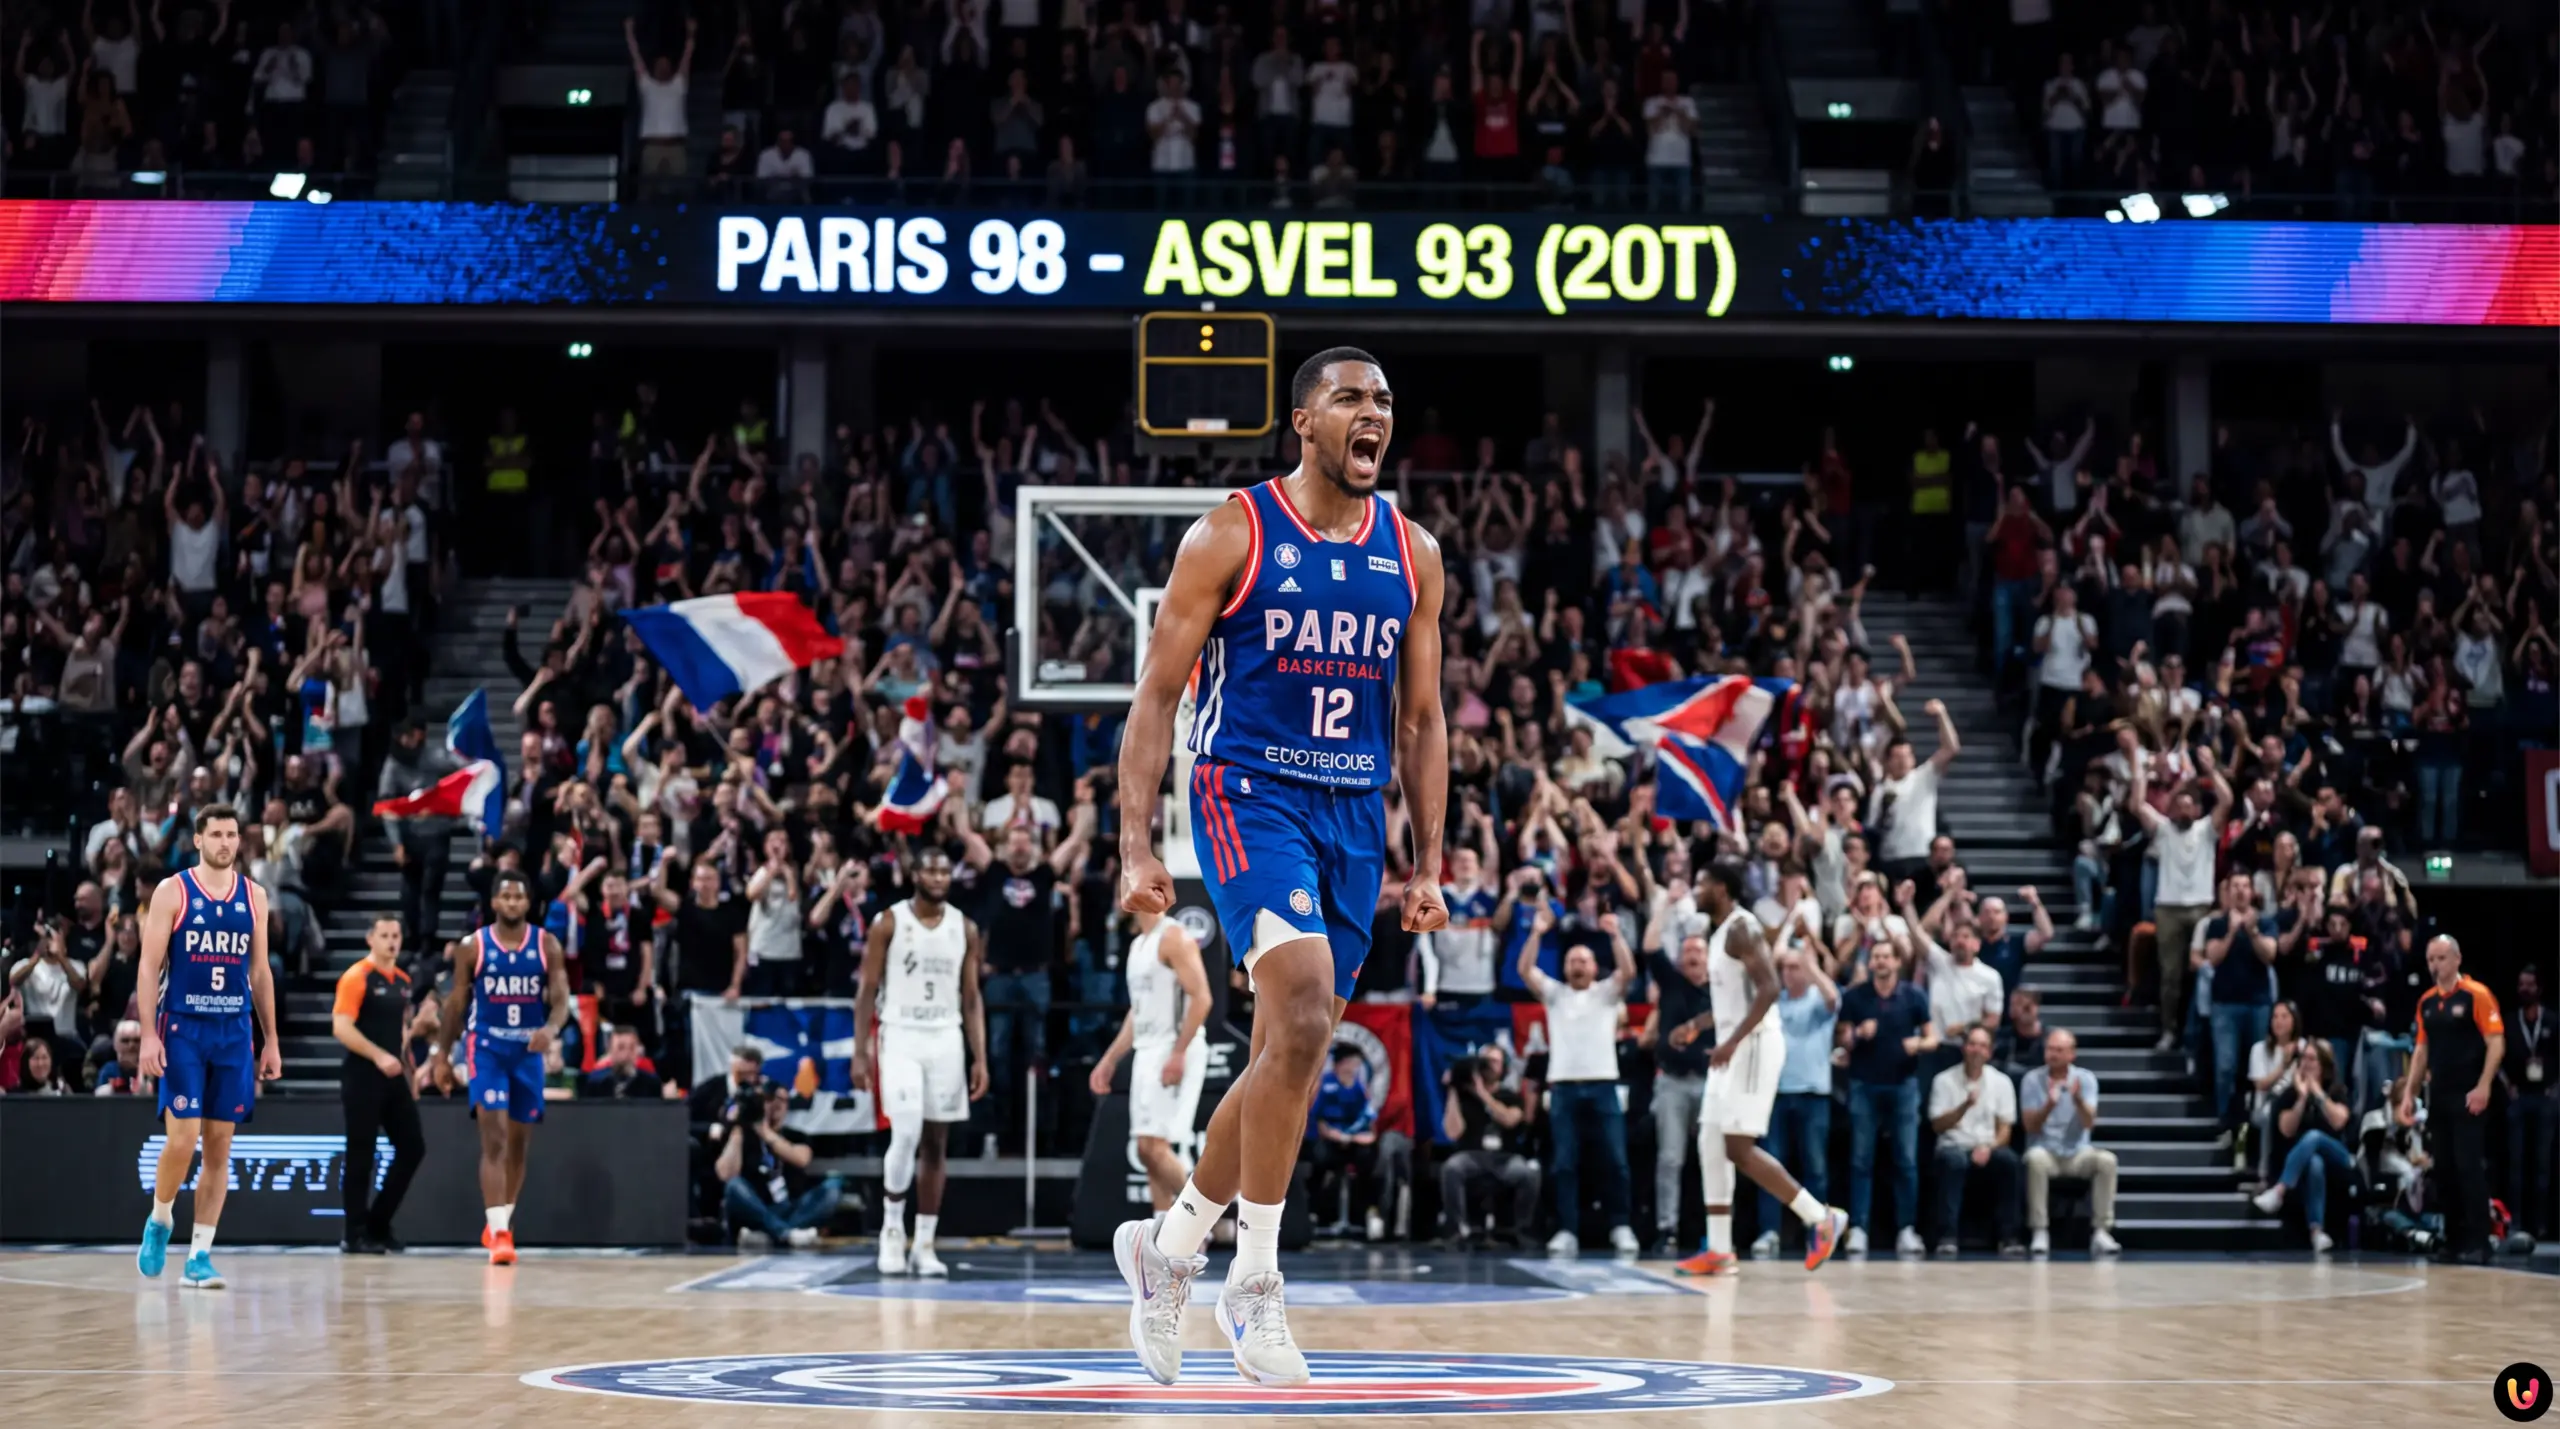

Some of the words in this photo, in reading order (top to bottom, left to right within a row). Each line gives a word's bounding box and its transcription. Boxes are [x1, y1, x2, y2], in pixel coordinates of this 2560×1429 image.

[716, 217, 949, 294] PARIS
[969, 219, 1068, 295] 98
[1143, 219, 1398, 299] ASVEL
[1415, 222, 1515, 300] 93
[1264, 608, 1401, 659] PARIS
[1276, 657, 1383, 680] BASKETBALL
[1311, 686, 1354, 739] 12
[185, 930, 251, 956] PARIS
[210, 966, 226, 991] 5
[483, 975, 541, 996] PARIS
